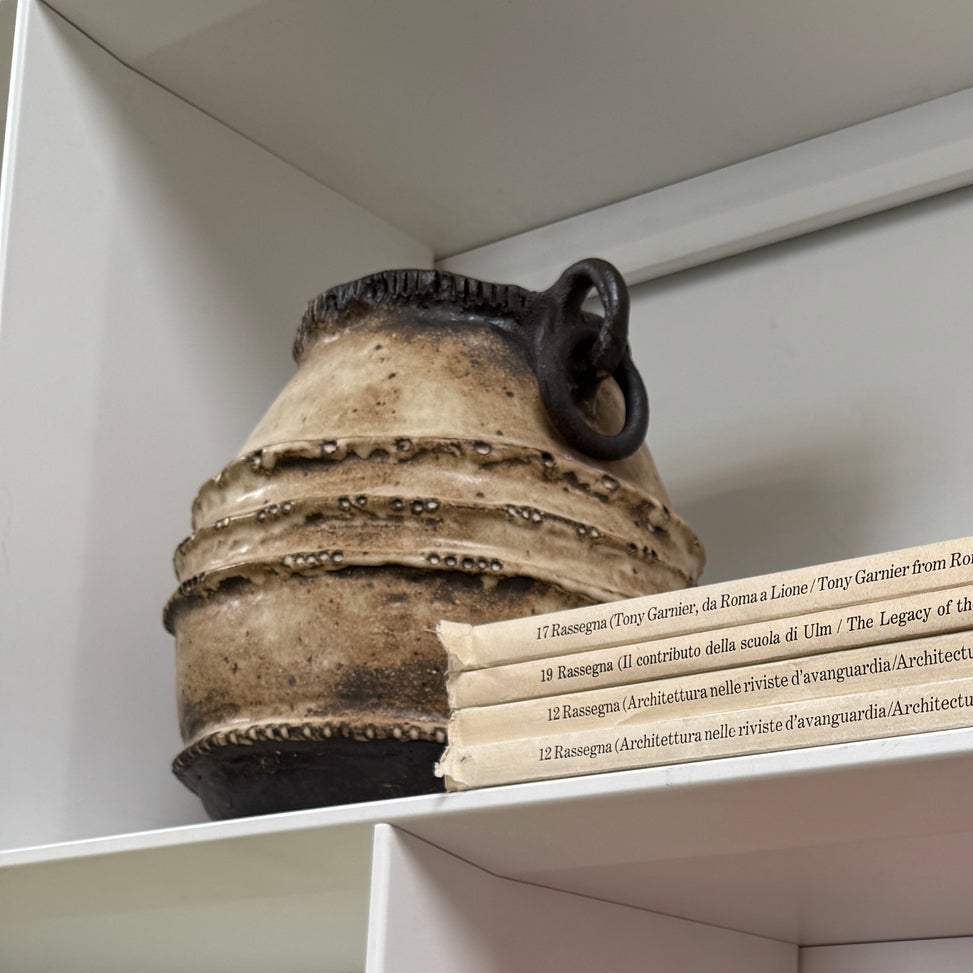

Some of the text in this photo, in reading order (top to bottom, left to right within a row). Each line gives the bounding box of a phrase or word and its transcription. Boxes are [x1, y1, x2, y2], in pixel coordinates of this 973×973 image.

[537, 626, 549, 640] 17
[551, 619, 607, 637] Rassegna
[610, 612, 645, 630] (Tony
[648, 602, 698, 621] Garnier,
[702, 597, 717, 611] da
[720, 593, 758, 608] Roma
[770, 584, 808, 600] Lione
[818, 576, 853, 591] Tony
[855, 564, 910, 584] Garnier
[912, 559, 946, 575] from
[541, 668, 553, 682] 19
[557, 662, 613, 679] Rassegna
[617, 653, 633, 670] (Il
[636, 647, 702, 668] contributo
[705, 638, 736, 655] della
[741, 631, 781, 649] scuola
[785, 626, 798, 642] di
[804, 623, 832, 639] Ulm
[847, 615, 873, 631] The
[880, 608, 932, 627] Legacy
[937, 599, 953, 616] of
[548, 707, 560, 721] 12
[563, 702, 620, 719] Rassegna
[623, 688, 708, 712] (Architettura
[710, 680, 741, 697] nelle
[744, 675, 788, 692] riviste
[539, 747, 551, 761] 12
[554, 743, 612, 759] Rassegna
[615, 731, 702, 753] (Architettura
[705, 724, 736, 740] nelle
[738, 719, 783, 736] riviste
